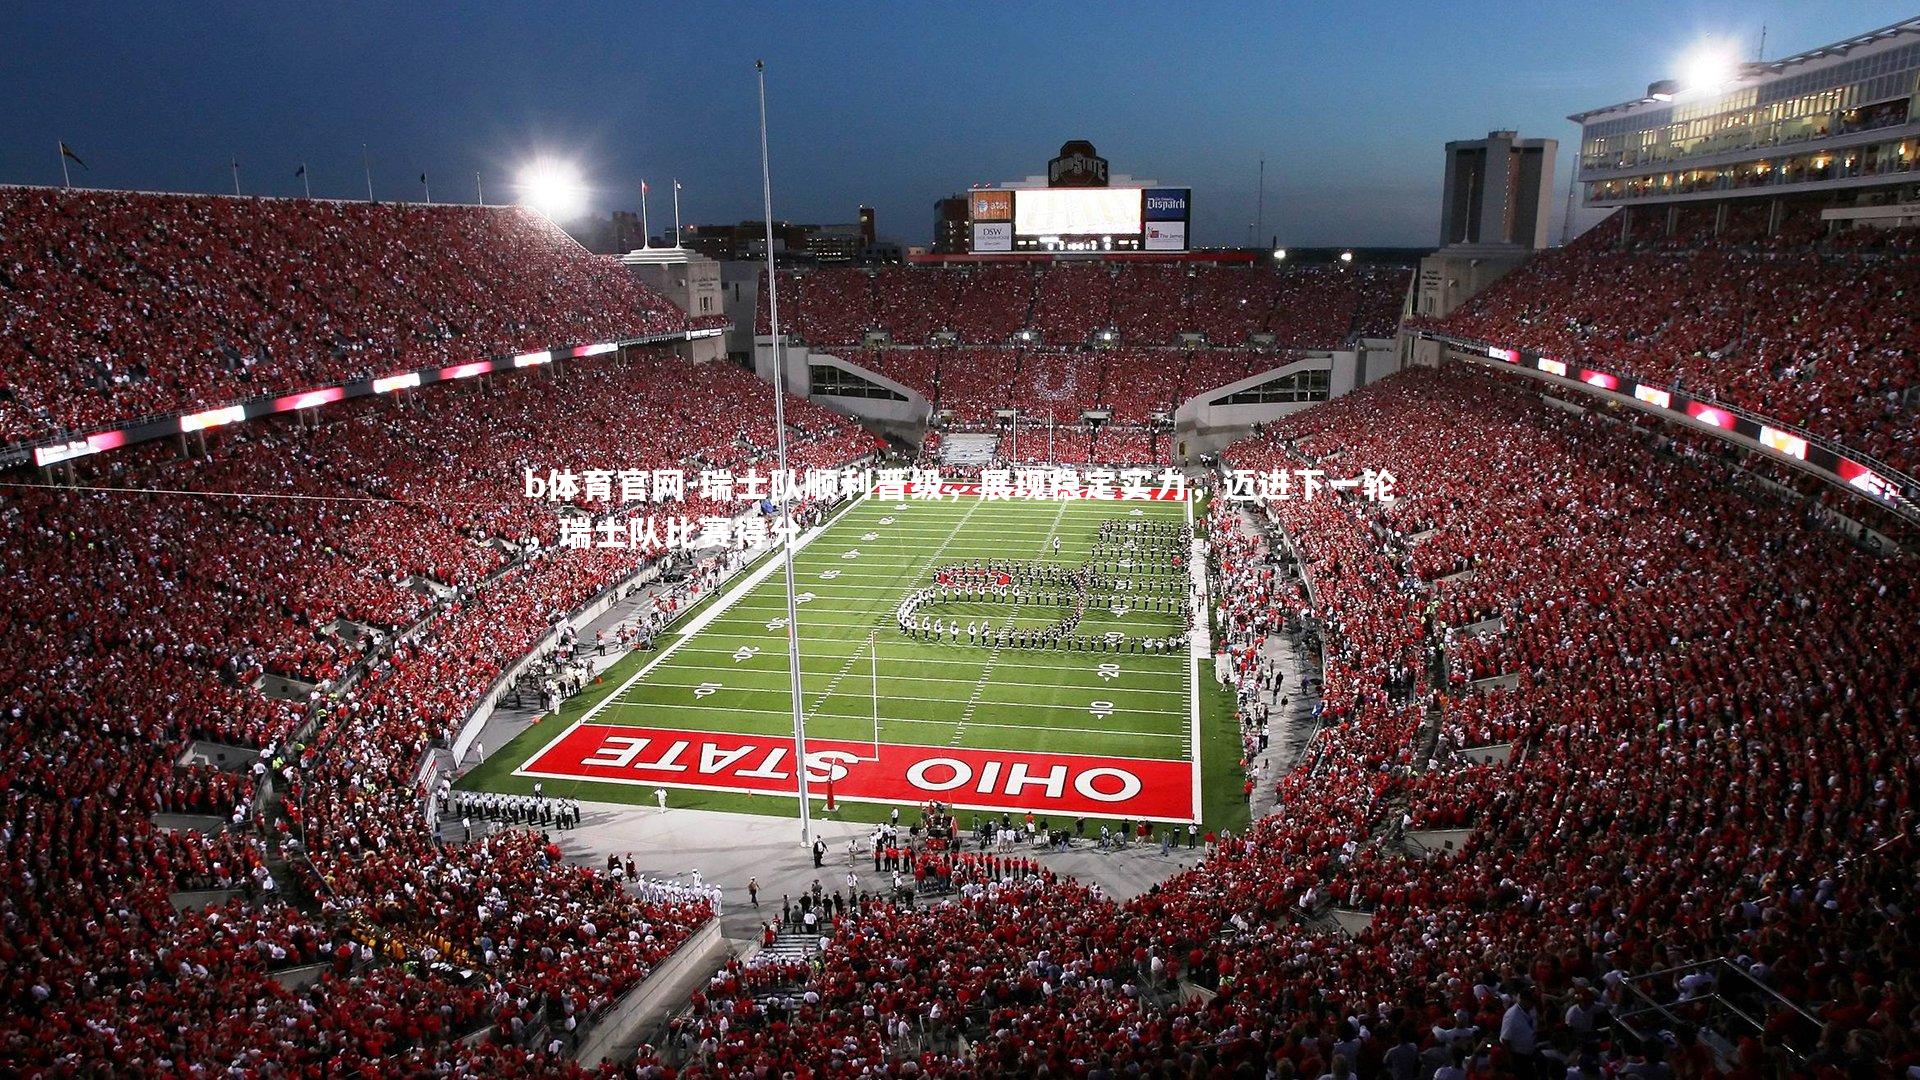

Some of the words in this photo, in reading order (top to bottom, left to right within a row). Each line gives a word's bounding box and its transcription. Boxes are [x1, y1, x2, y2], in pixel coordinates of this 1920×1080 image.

[1147, 197, 1185, 211] Dispatch
[983, 228, 1002, 236] DSW
[732, 645, 760, 659] 20
[1097, 663, 1120, 678] 20
[693, 682, 723, 696] 10
[1089, 701, 1114, 715] 10
[580, 736, 859, 783] STATE
[906, 757, 1143, 803] OHIO
